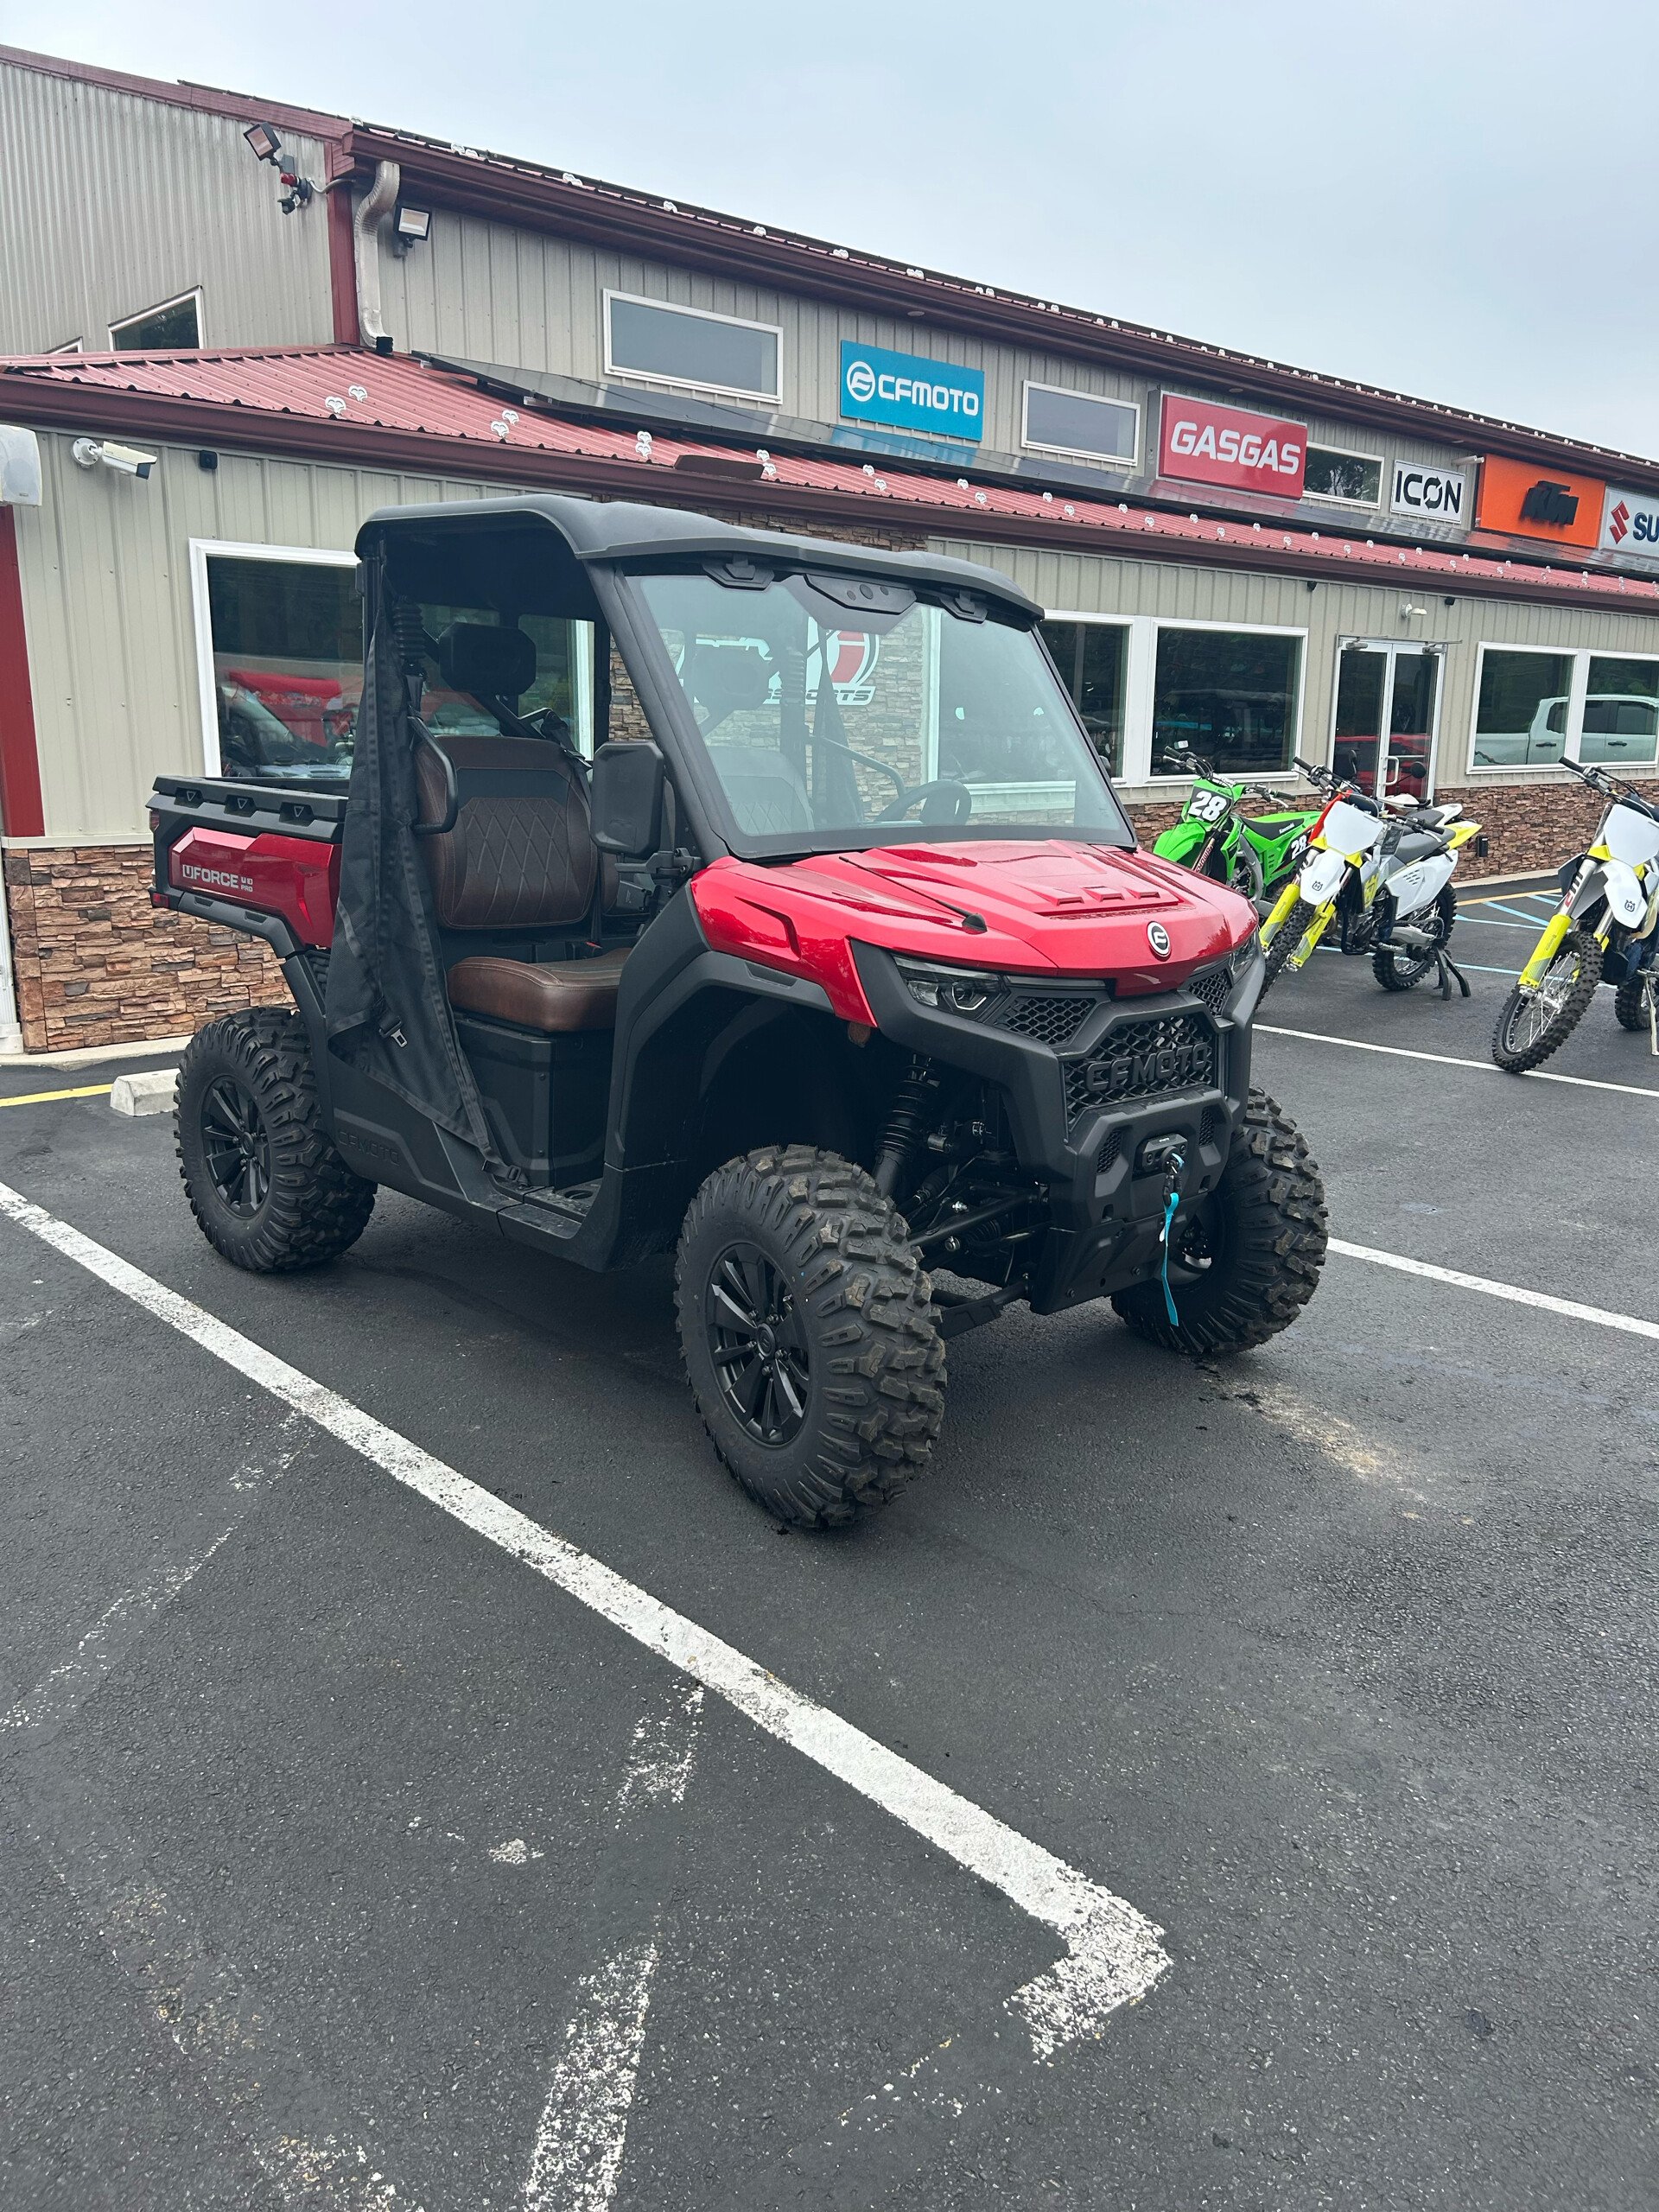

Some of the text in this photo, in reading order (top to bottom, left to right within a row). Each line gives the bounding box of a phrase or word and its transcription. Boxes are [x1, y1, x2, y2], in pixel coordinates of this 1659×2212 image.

[878, 374, 979, 416] CFMOTO
[1170, 421, 1301, 475] GASGAS
[1395, 470, 1462, 514] ICON
[1187, 791, 1227, 822] 28
[1291, 834, 1307, 861] 28
[1086, 1042, 1209, 1092] CFMOTO
